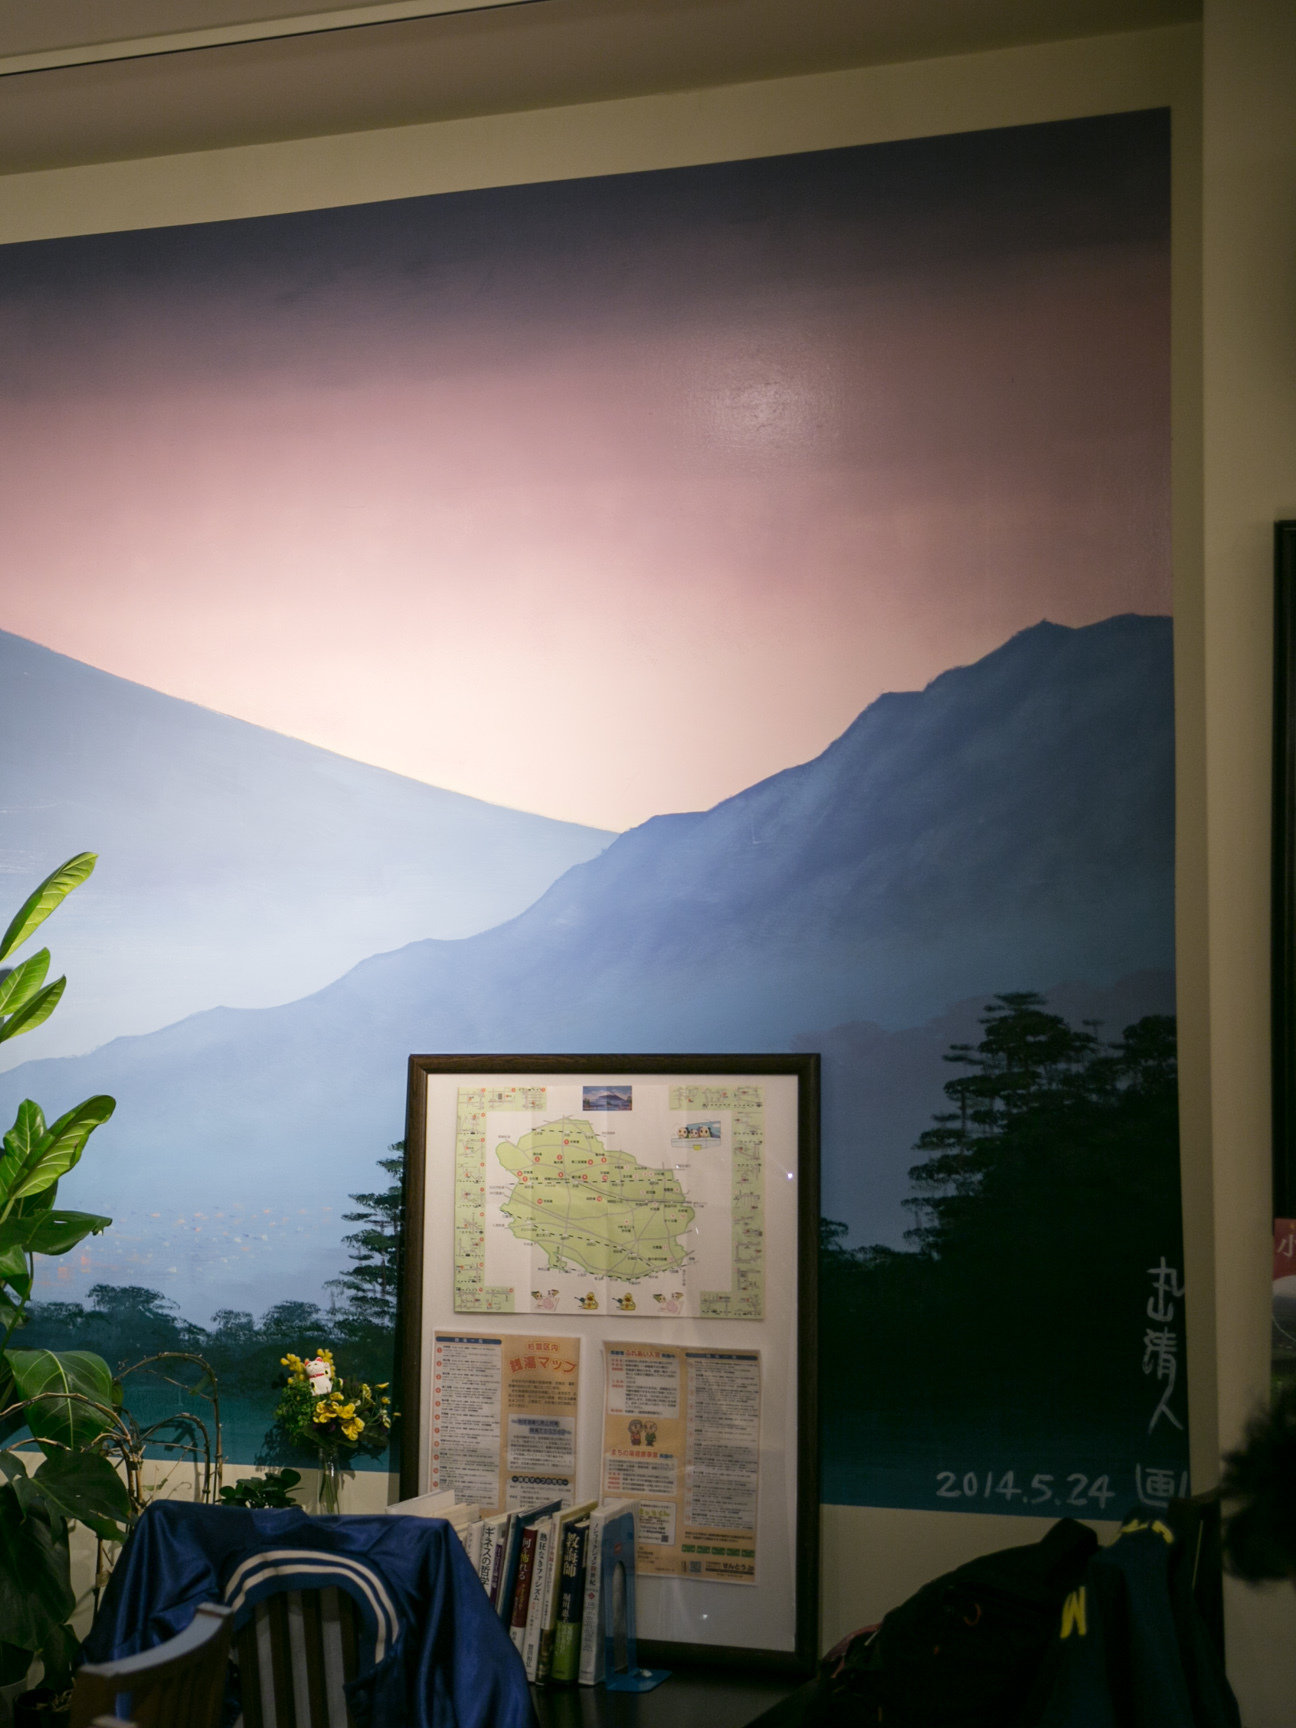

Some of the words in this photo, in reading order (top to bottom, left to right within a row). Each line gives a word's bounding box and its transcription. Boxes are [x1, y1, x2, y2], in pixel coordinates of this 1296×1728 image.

[527, 1342, 560, 1352] 杉並区内
[509, 1355, 578, 1375] 銭湯マップ
[936, 1470, 1116, 1510] 2014.5.24
[480, 1526, 496, 1586] ギネスの哲学
